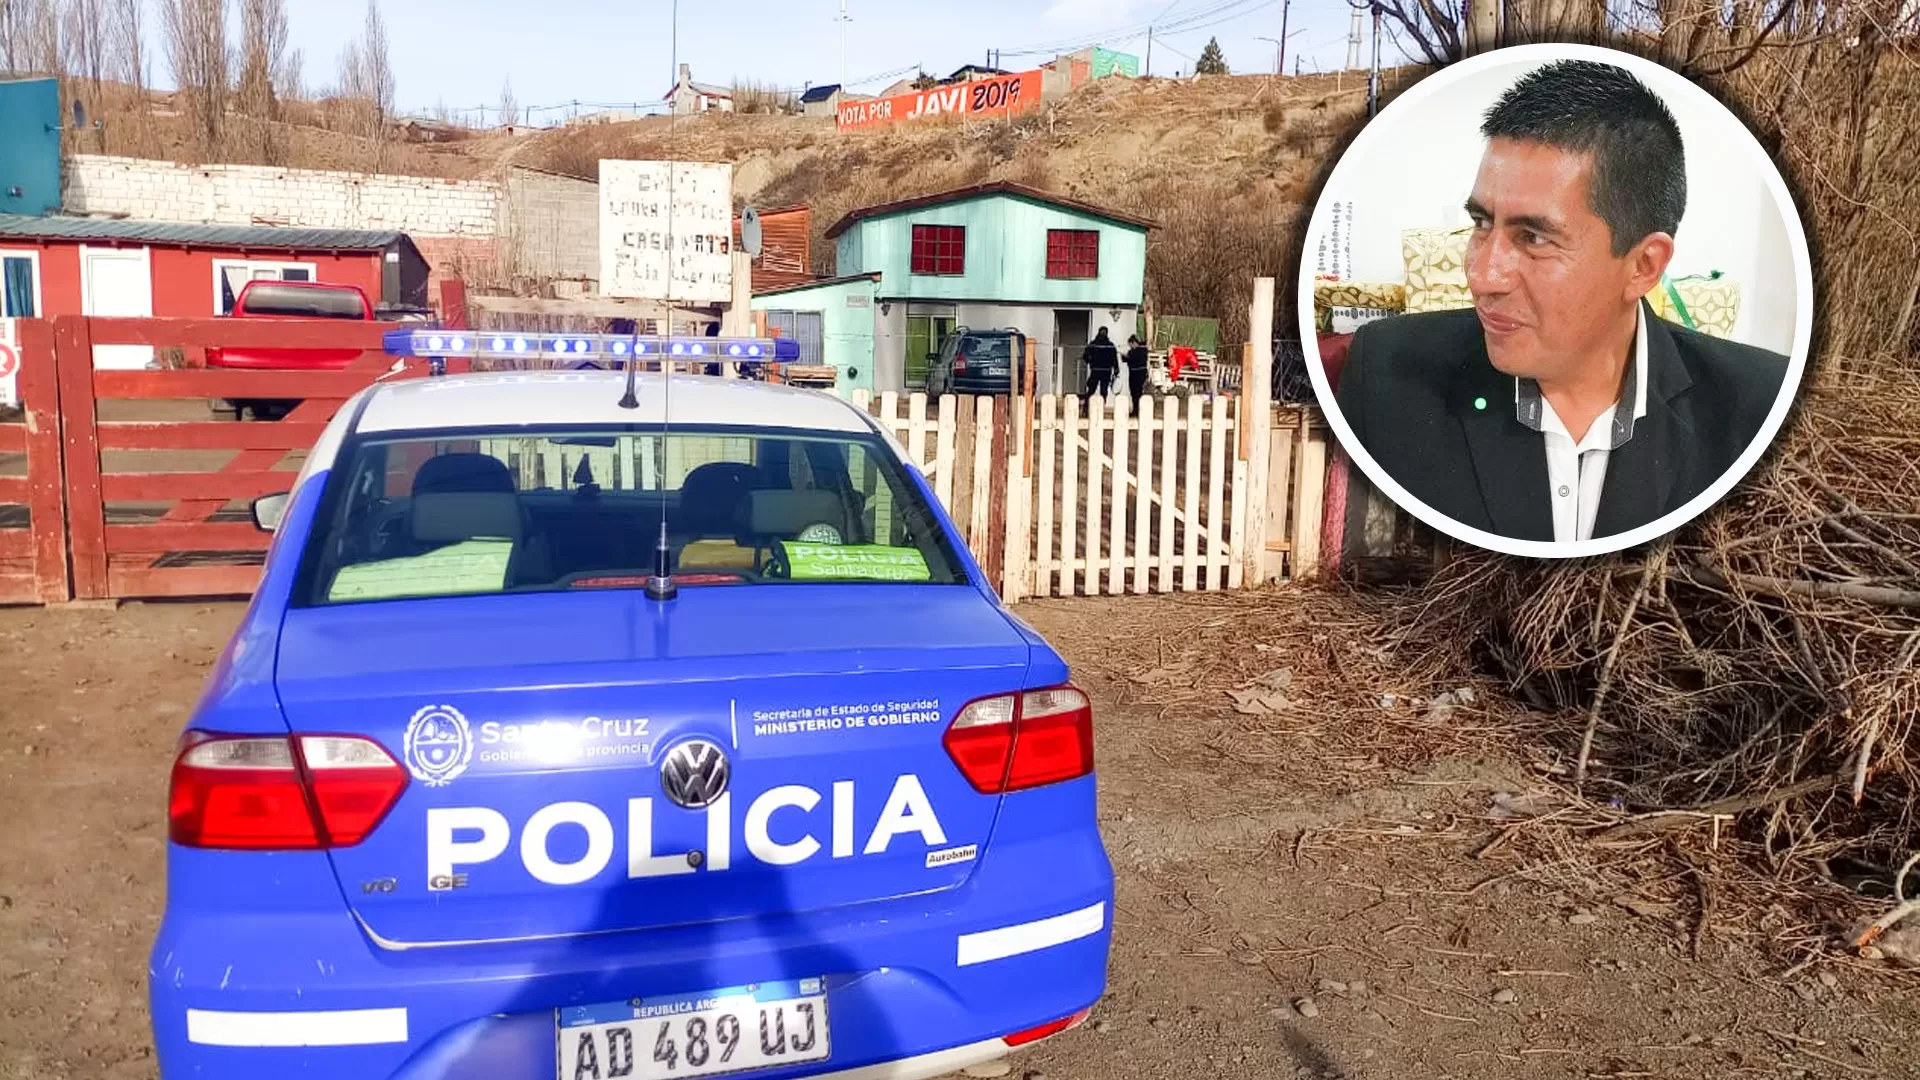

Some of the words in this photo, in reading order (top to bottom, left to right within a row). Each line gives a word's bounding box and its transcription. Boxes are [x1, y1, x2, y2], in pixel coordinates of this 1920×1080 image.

[838, 109, 867, 126] VOTA
[869, 100, 892, 120] POR
[907, 86, 968, 120] JAVI
[972, 78, 1020, 113] 2019
[795, 546, 920, 565] POLICIA
[810, 561, 868, 576] Santa
[815, 706, 829, 717] de
[831, 703, 869, 716] Estado
[871, 701, 885, 713] de
[887, 698, 939, 713] Seguridad
[582, 716, 649, 738] Cruz
[755, 718, 842, 737] MINISTERIO
[845, 716, 866, 729] DE
[868, 711, 940, 728] GOBIERNO
[587, 742, 650, 757] provincia
[427, 773, 948, 892] POLICIA
[928, 848, 975, 864] Autobahn
[633, 1000, 693, 1018] REPUBLICA
[574, 1026, 634, 1080] AD
[653, 1013, 741, 1070] 489
[759, 1002, 816, 1056] UJ
